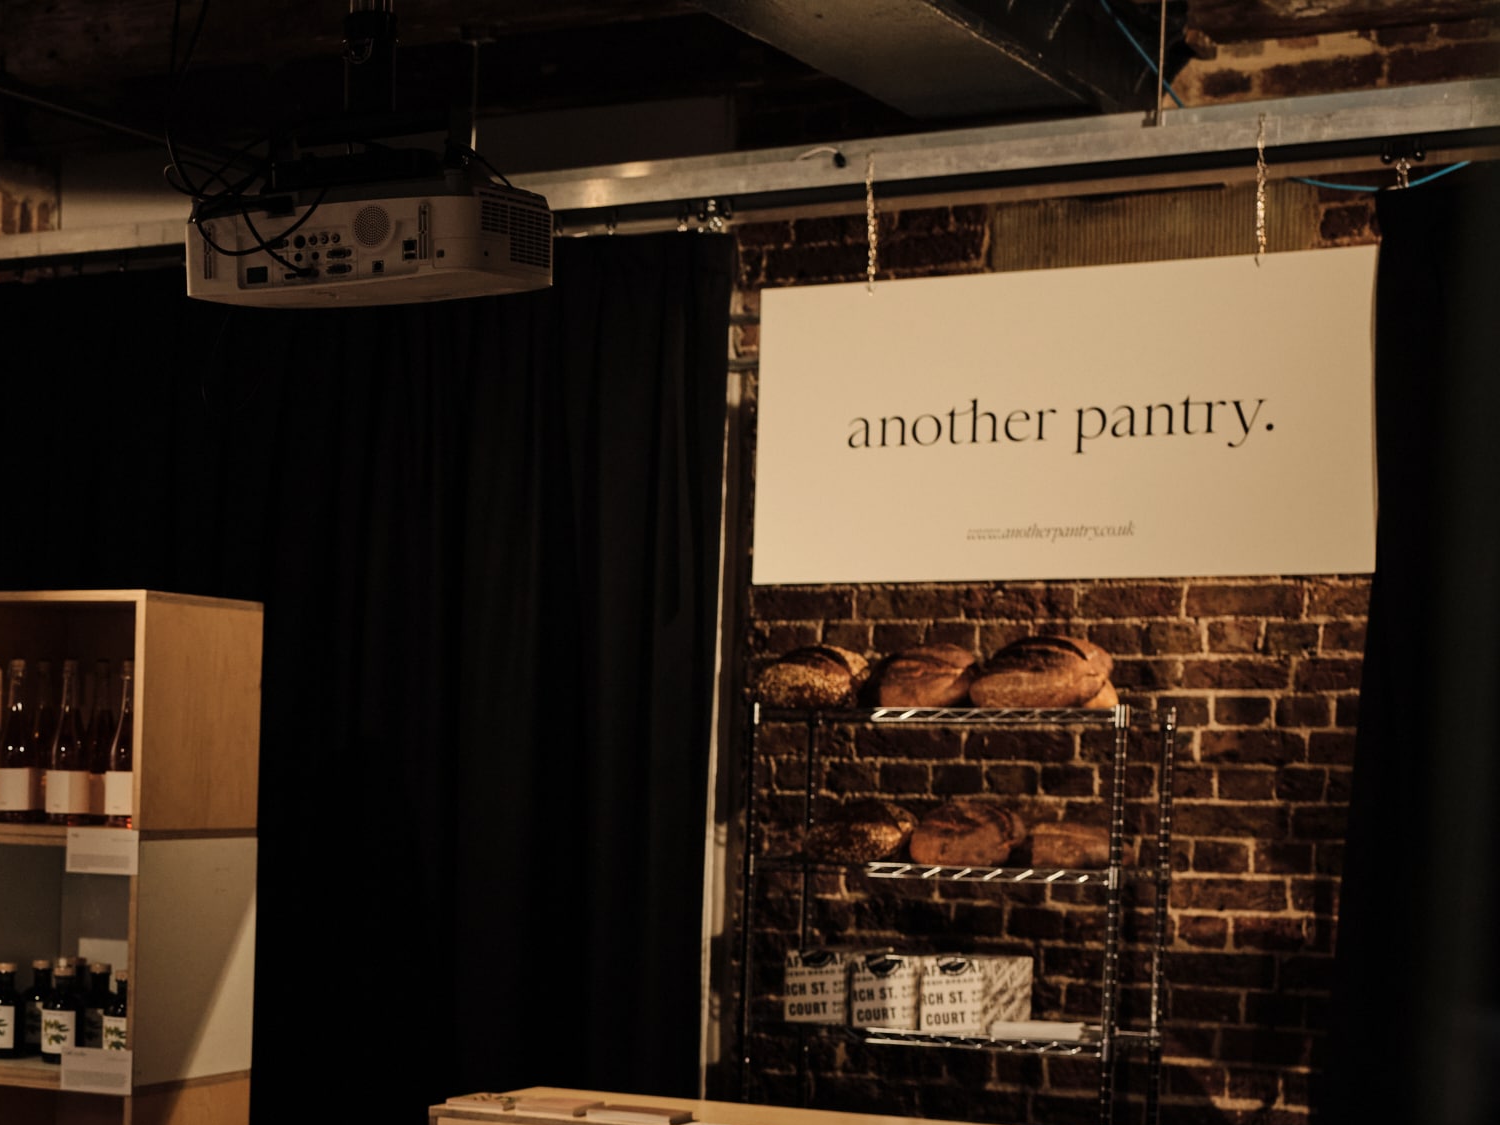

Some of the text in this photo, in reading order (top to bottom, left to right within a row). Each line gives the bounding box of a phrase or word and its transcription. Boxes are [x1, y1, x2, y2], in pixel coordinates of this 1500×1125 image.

[847, 395, 1275, 455] another pantry.
[788, 1001, 827, 1016] COURT
[856, 1007, 896, 1022] COURT
[925, 1011, 965, 1026] COURT
